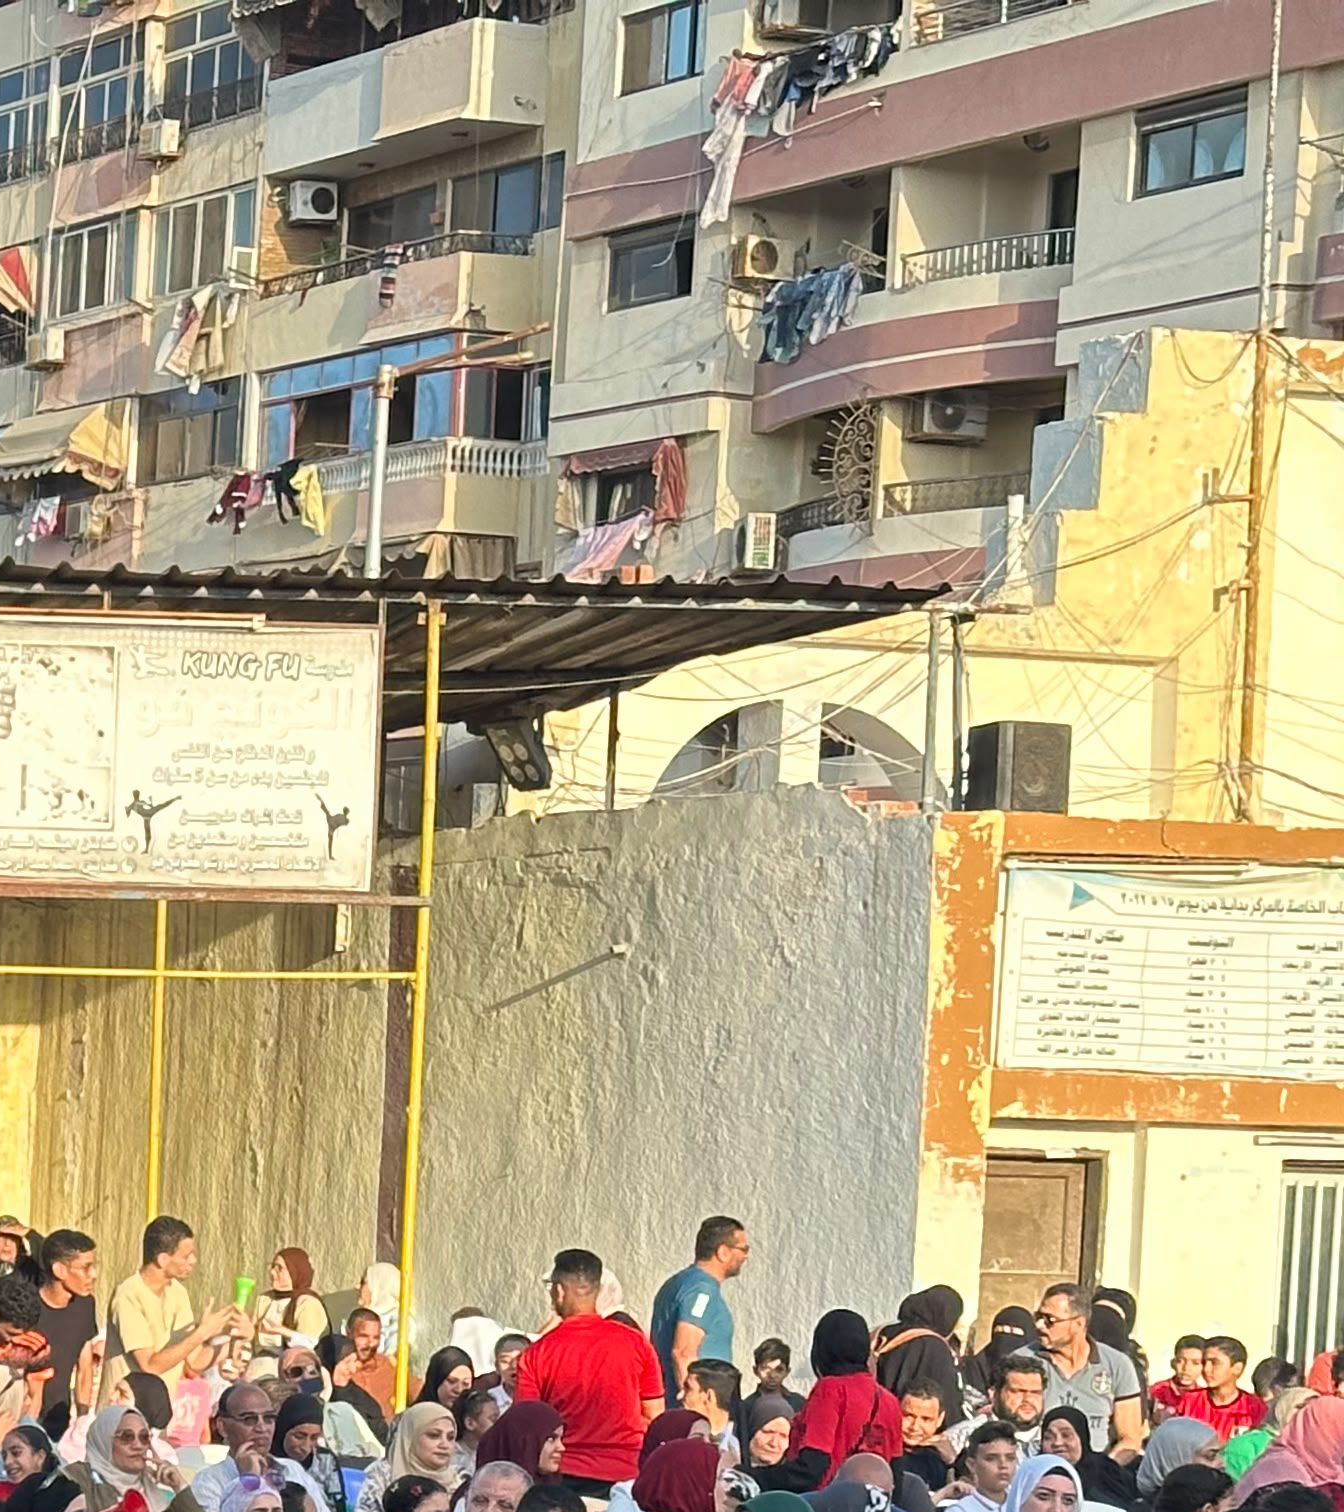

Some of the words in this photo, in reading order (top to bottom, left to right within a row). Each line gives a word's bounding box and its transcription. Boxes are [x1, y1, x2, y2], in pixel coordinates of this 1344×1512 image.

[181, 651, 261, 680] KUNG
[264, 652, 301, 681] FU
[193, 767, 204, 784] 5
